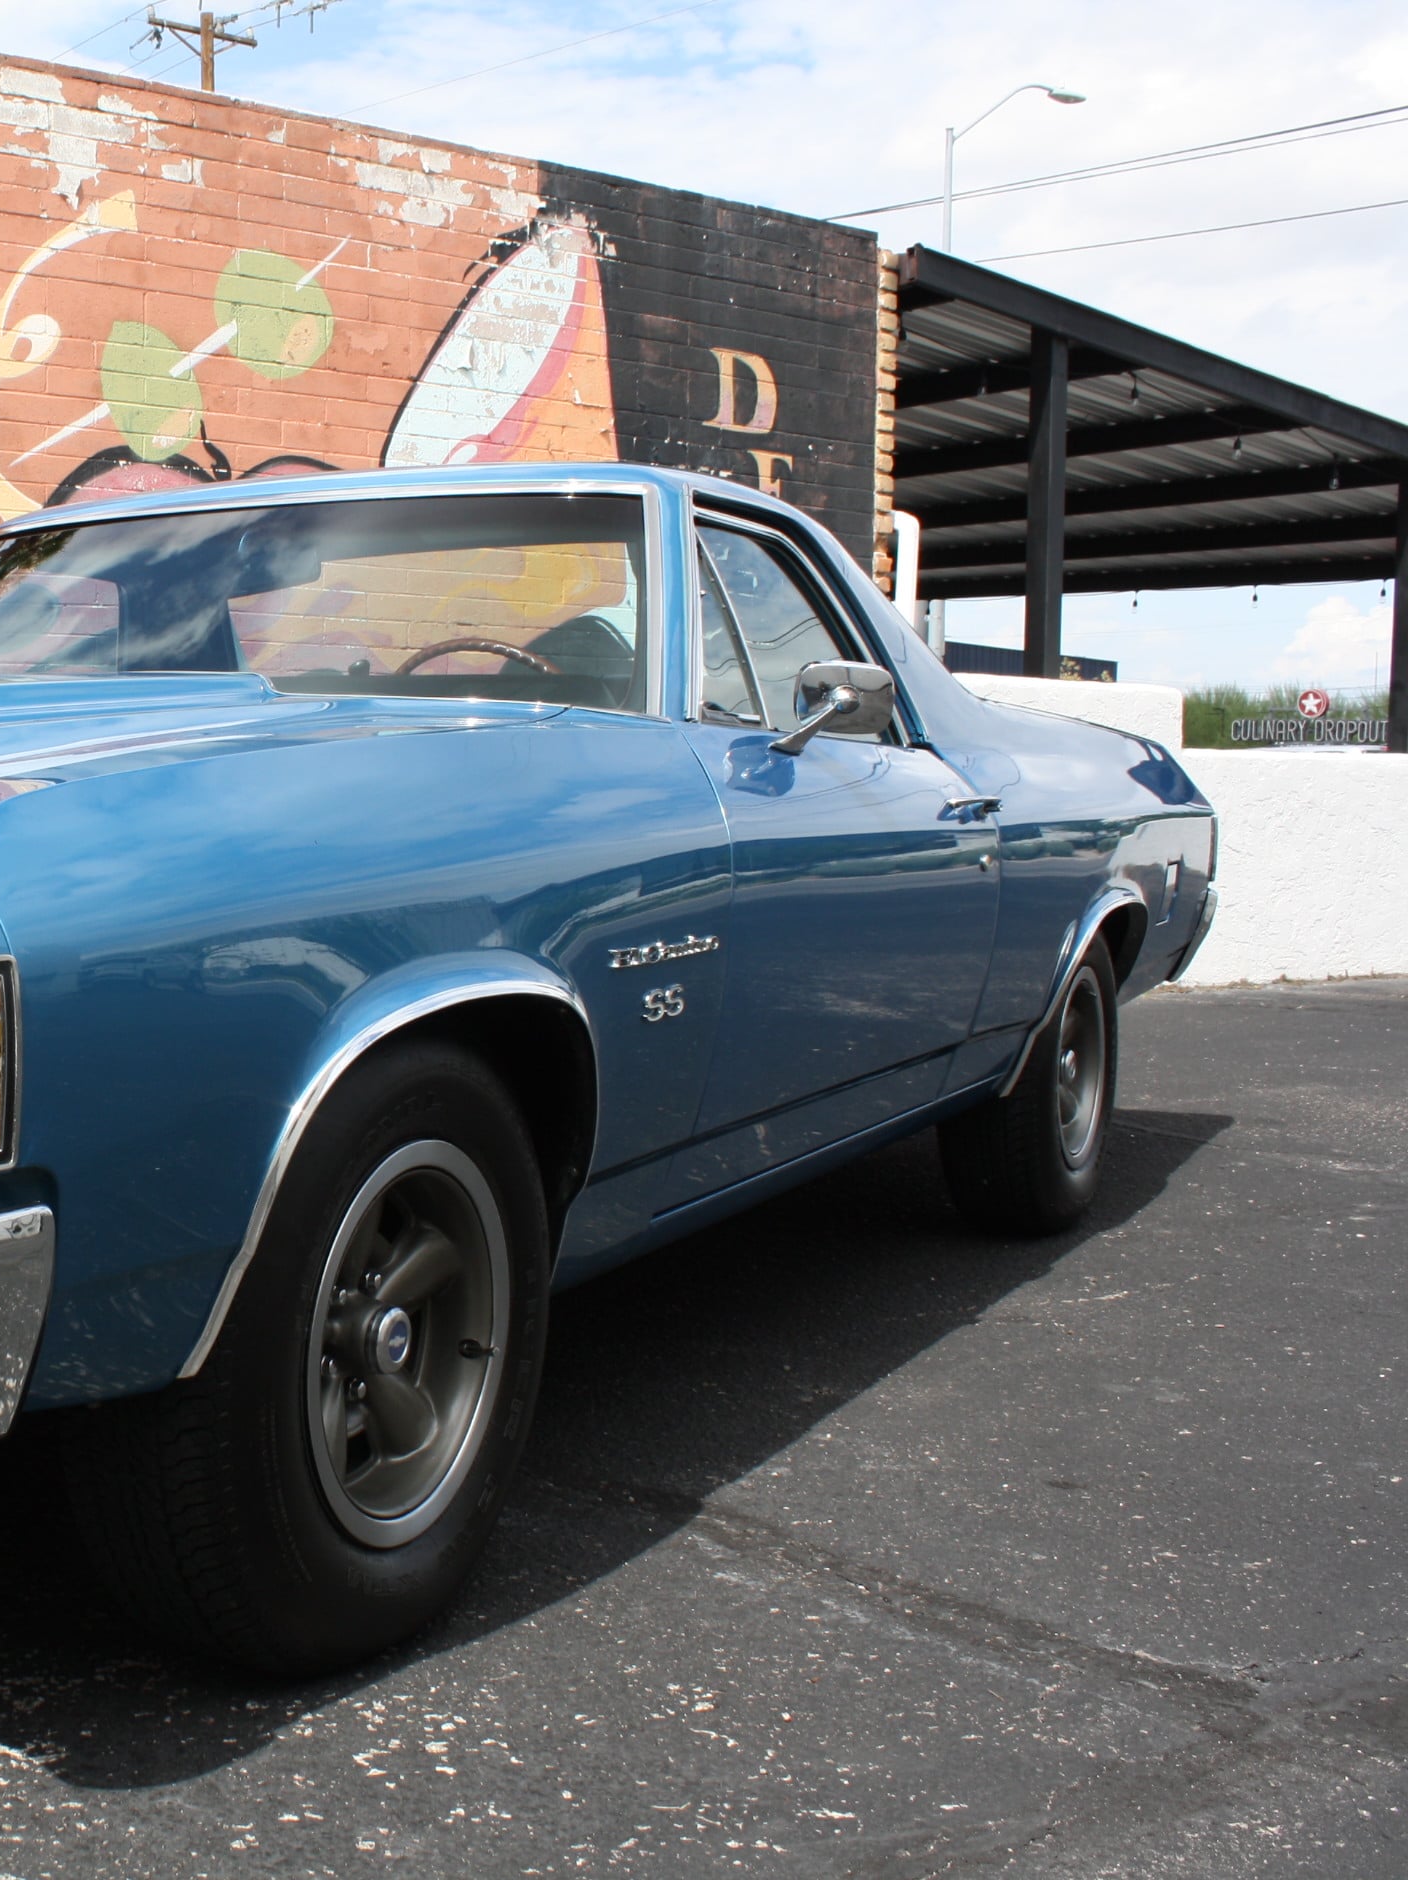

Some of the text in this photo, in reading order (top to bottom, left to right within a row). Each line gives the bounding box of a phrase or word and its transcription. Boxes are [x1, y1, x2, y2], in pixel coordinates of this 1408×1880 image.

[702, 347, 779, 434] D
[1231, 719, 1389, 743] CULINARY DROPOUT
[643, 983, 685, 1022] SS
